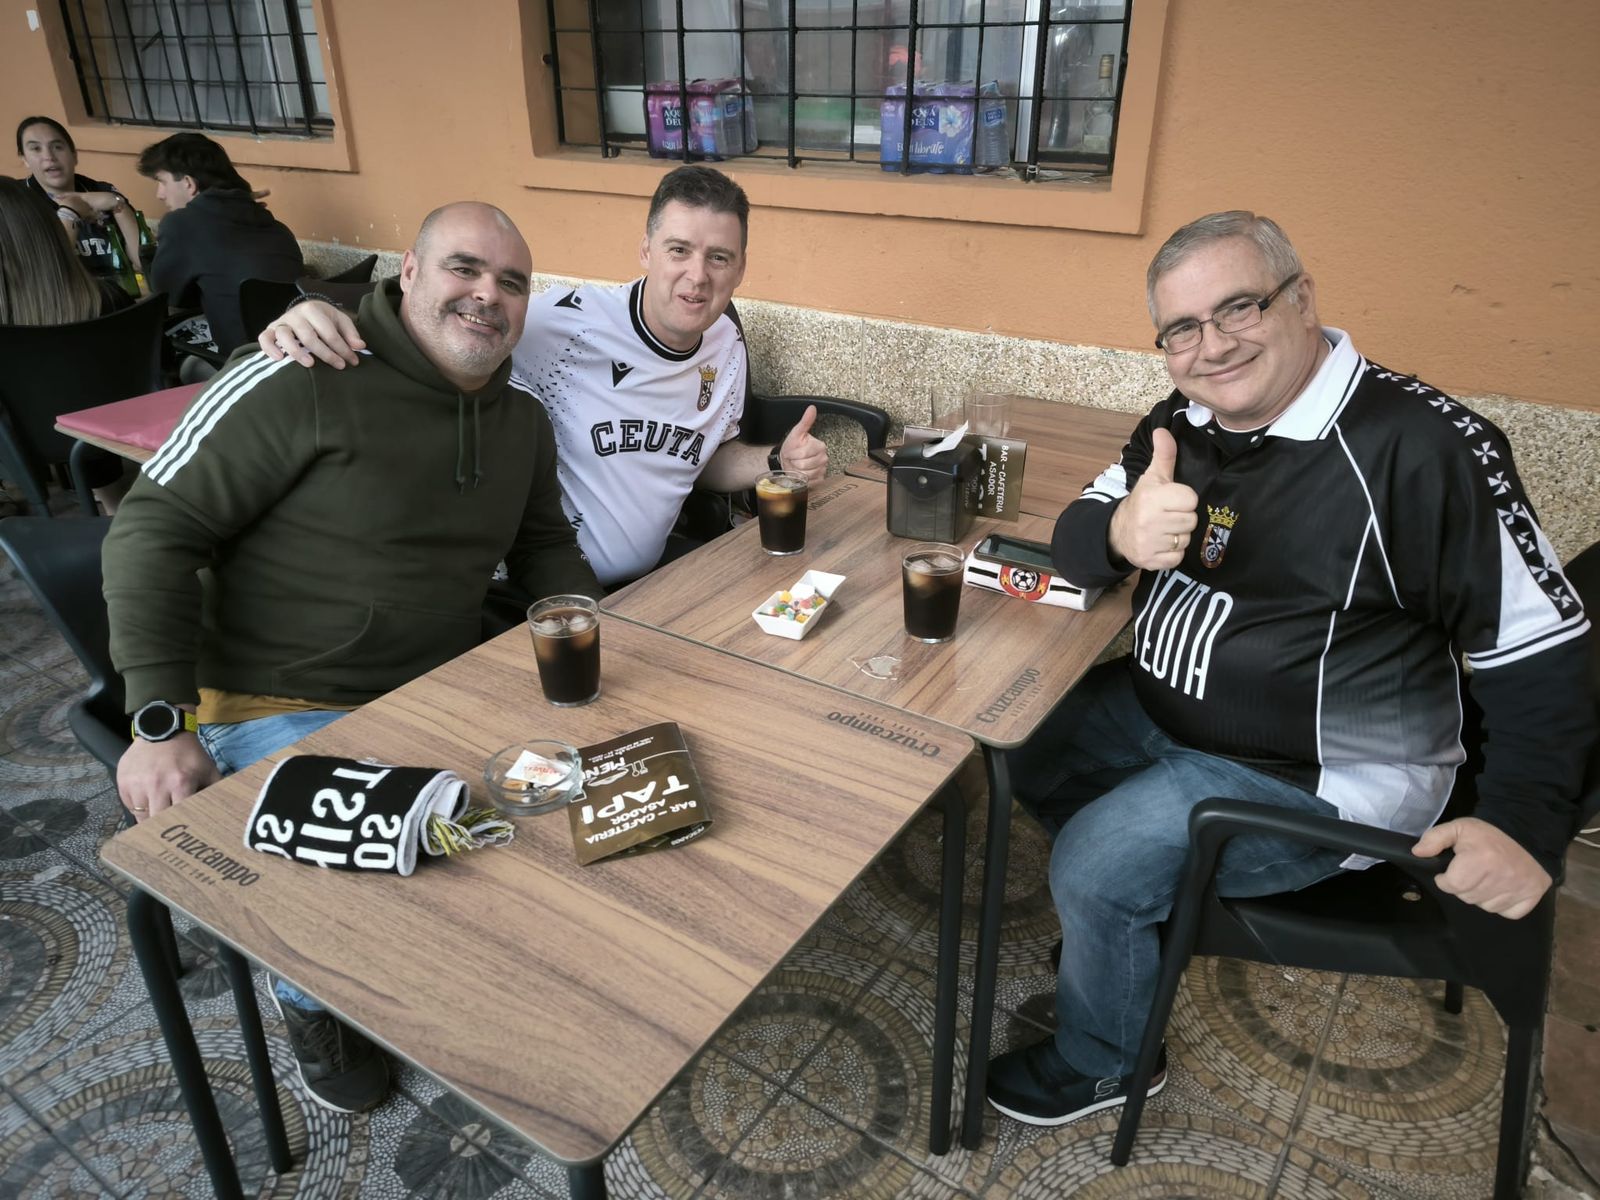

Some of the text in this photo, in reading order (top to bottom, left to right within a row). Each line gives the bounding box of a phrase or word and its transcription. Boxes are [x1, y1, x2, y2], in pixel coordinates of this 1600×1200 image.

[911, 105, 936, 117] QUA
[590, 419, 706, 466] CEUTA
[1000, 444, 1009, 462] BAR
[988, 461, 997, 496] ASADOR
[996, 471, 1006, 513] CAFETERIA
[976, 667, 1041, 724] Cruzcampo
[827, 711, 941, 758] Cruzcampo
[582, 757, 626, 779] MEN
[581, 775, 689, 824] TAPI
[610, 798, 666, 825] ASADOR
[669, 800, 697, 812] BAR
[585, 813, 656, 844] CAFETERIA
[160, 824, 260, 887] Cruzcampo
